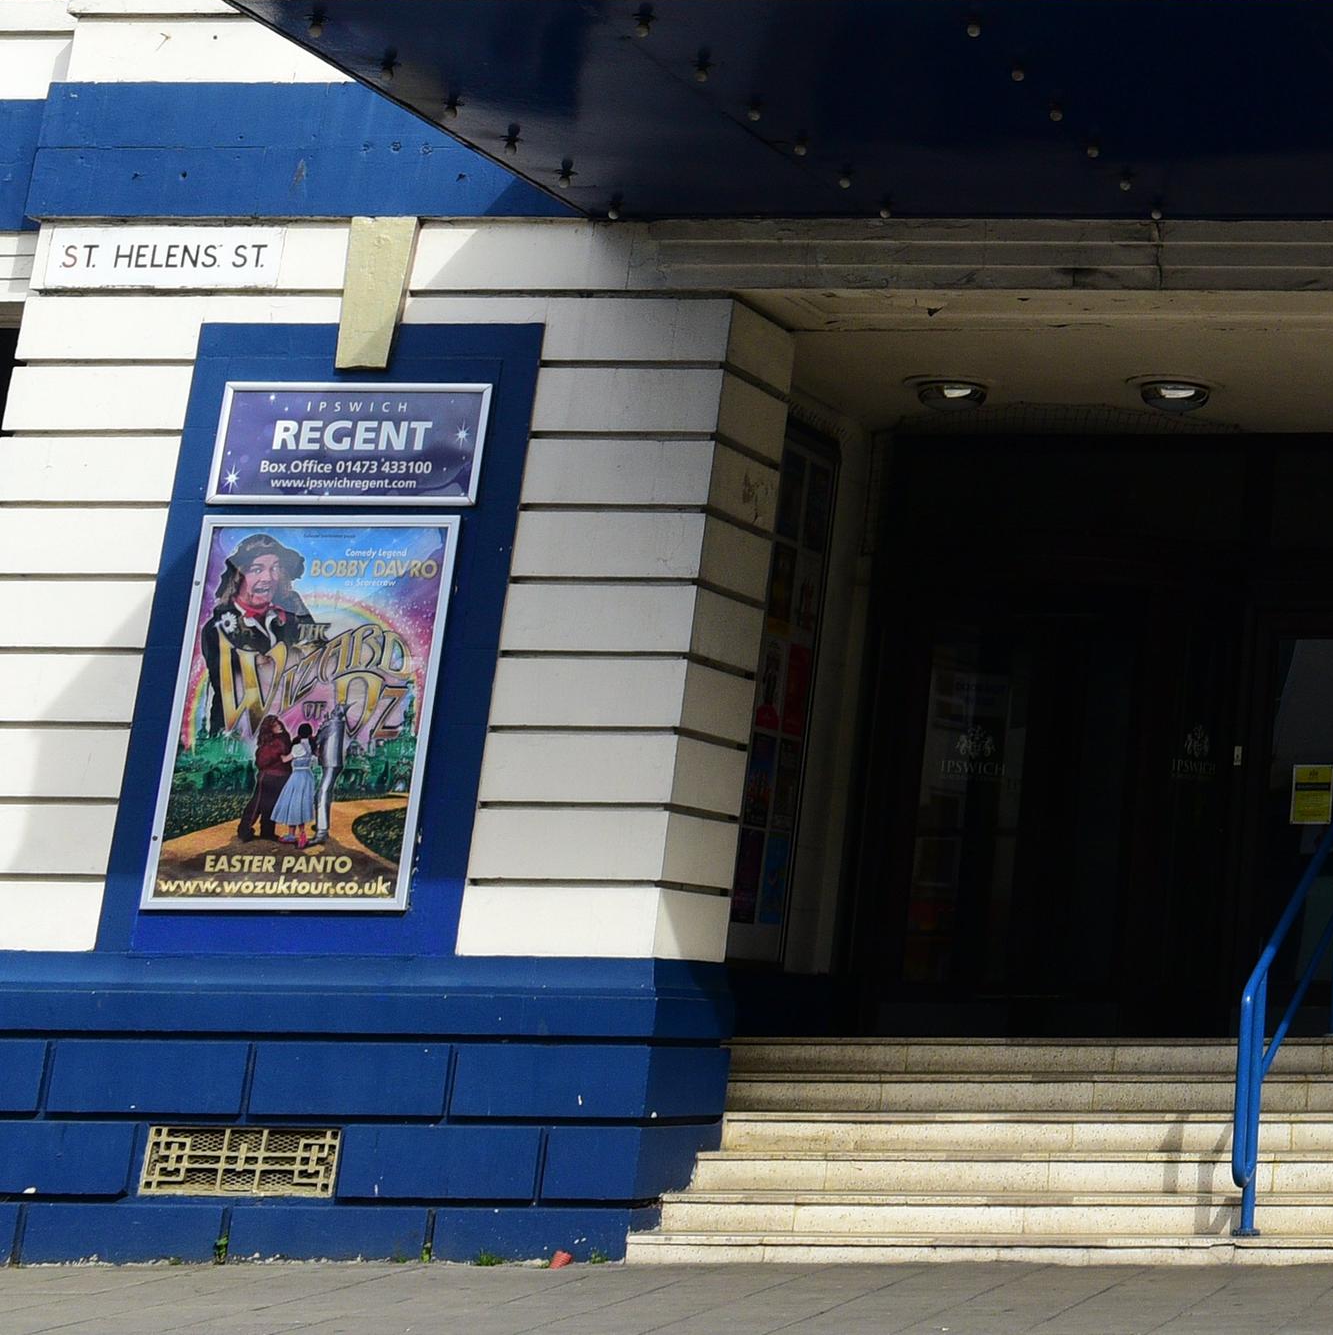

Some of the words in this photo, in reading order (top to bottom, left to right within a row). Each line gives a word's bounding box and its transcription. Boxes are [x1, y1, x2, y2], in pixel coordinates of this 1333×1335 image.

[232, 244, 268, 268] ST.
[306, 401, 409, 413] IPSWICH
[271, 419, 434, 451] REGENT
[260, 460, 286, 473] Box
[290, 459, 332, 474] Office
[336, 460, 377, 474] 01473
[381, 460, 433, 474] 433100
[270, 477, 417, 490] www.ipswichregent.com
[345, 548, 377, 559] Comedy
[378, 548, 408, 558] Legend
[310, 559, 370, 578] BOBBY
[373, 559, 438, 579] DAVRO
[297, 623, 331, 641] THE
[333, 669, 410, 739] OZ
[204, 855, 275, 873] EASTER
[281, 855, 353, 873] PANTO
[159, 875, 390, 895] www.wozuktour.co.uk
